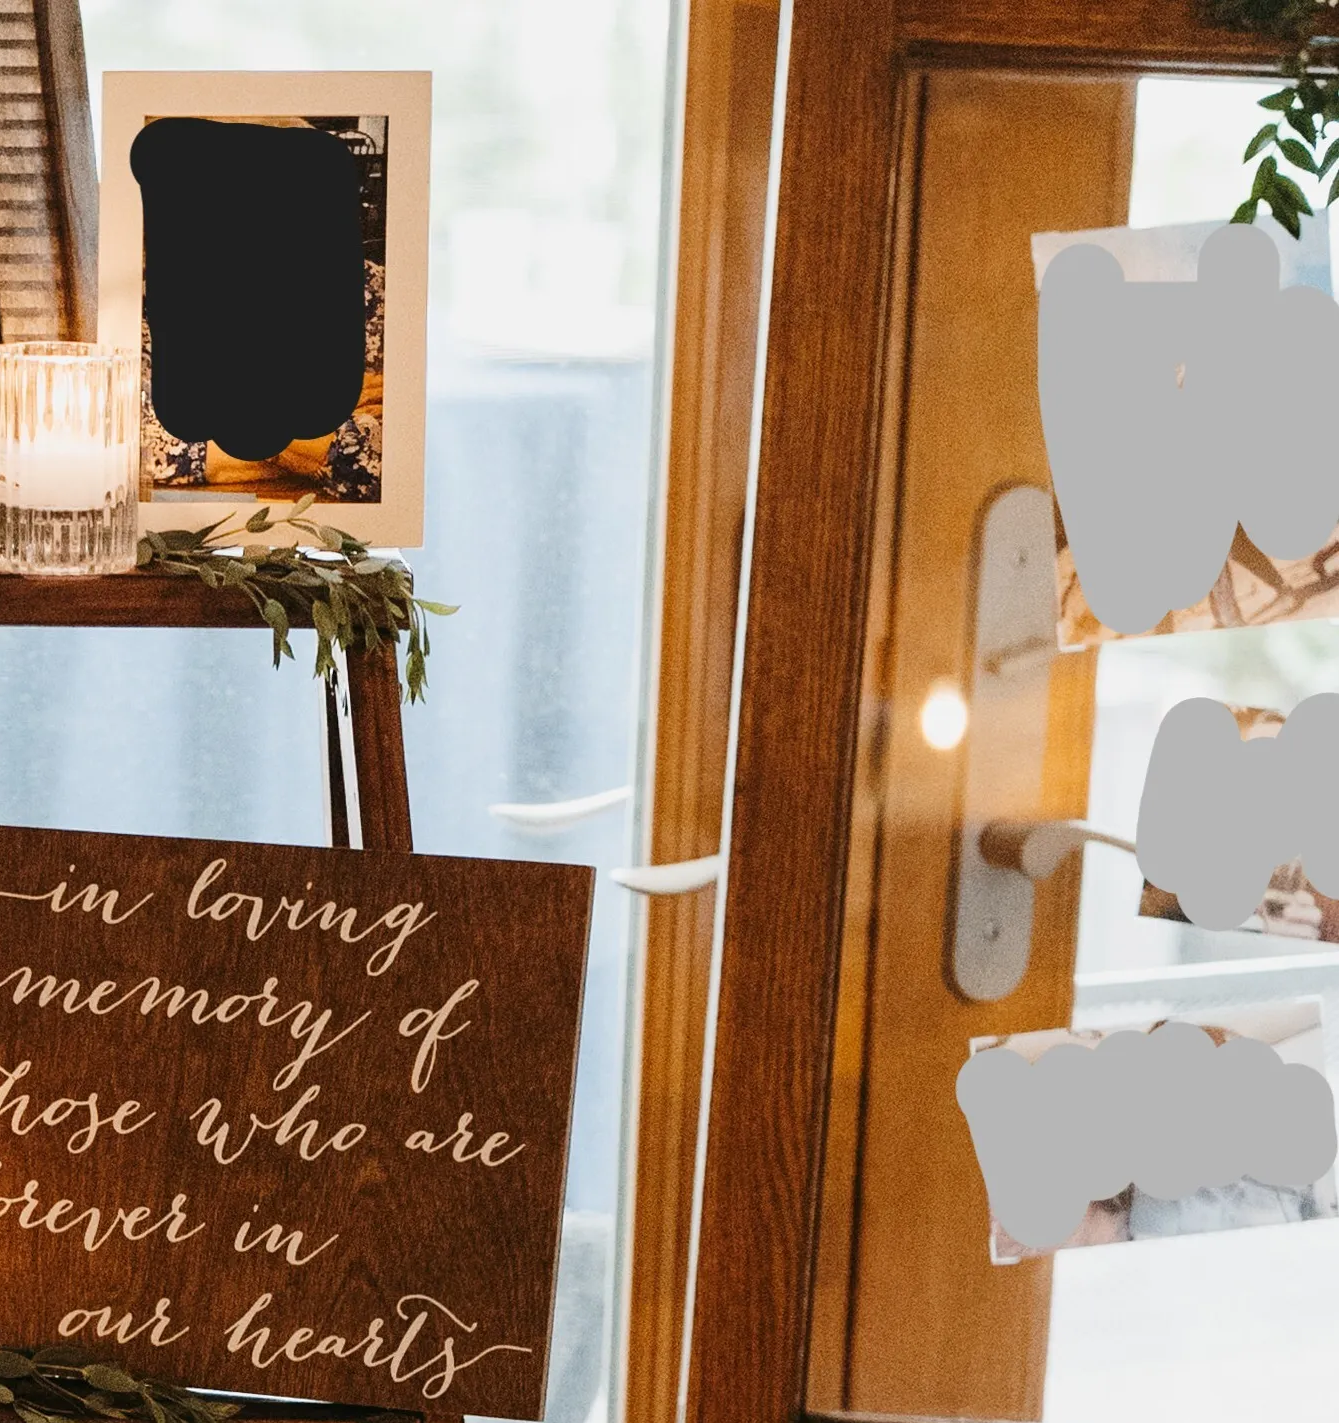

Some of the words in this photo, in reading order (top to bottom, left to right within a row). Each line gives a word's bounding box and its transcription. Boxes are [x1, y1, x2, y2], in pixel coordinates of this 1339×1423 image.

[187, 858, 438, 977] loving
[398, 978, 480, 1094] of
[189, 1084, 367, 1165] who
[404, 1112, 526, 1167] are
[233, 1203, 340, 1266] in
[57, 1297, 190, 1347] our
[223, 1292, 533, 1399] hearts
